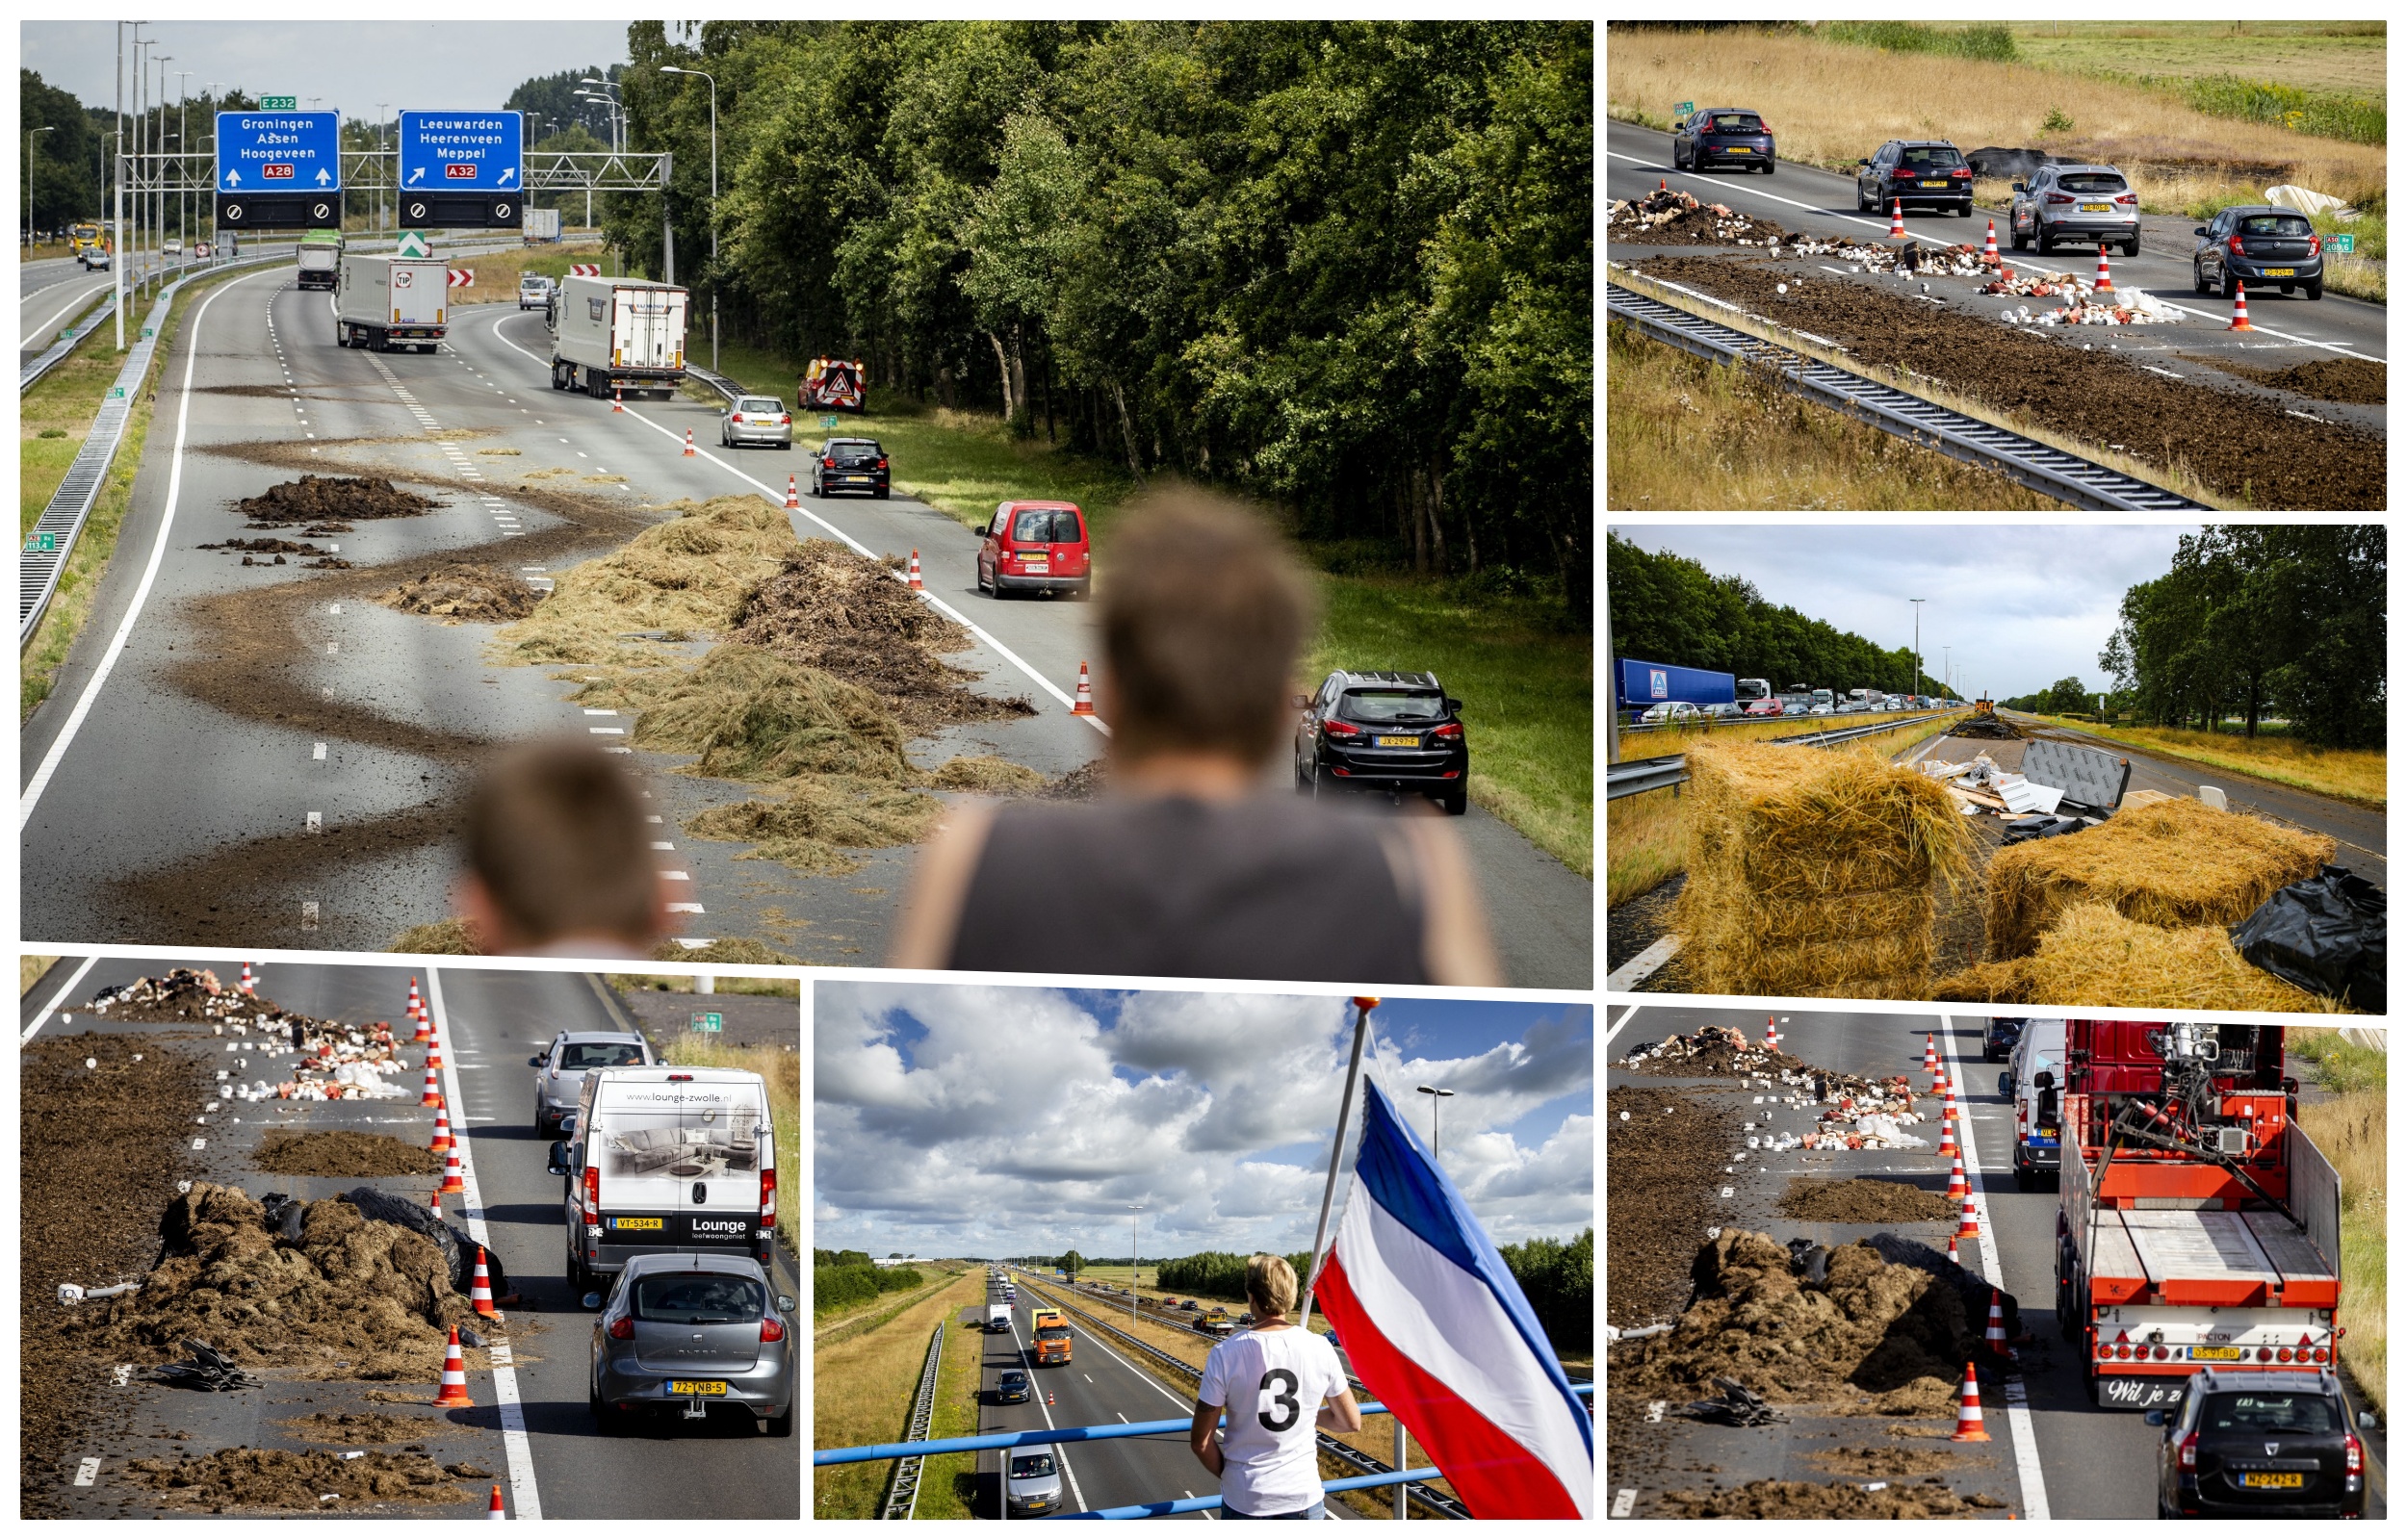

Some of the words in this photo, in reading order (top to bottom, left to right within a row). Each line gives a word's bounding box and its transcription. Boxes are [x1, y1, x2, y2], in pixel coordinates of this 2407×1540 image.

[242, 118, 314, 132] Groningen
[420, 118, 503, 130] Leeuwarden
[257, 133, 298, 143] Assen
[420, 133, 503, 144] Heerenveen
[241, 148, 316, 161] Hoogeveen
[437, 147, 485, 161] Meppel
[1975, 701, 1994, 712] HELP
[626, 1092, 732, 1104] www.lounge-zwolle.nl
[619, 1219, 659, 1227] VT-534-R
[692, 1218, 747, 1233] Lounge
[675, 1382, 722, 1392] 72-TNB-5
[2108, 1379, 2144, 1401] Wil
[2138, 1384, 2164, 1407] je
[1257, 1368, 1301, 1432] 3
